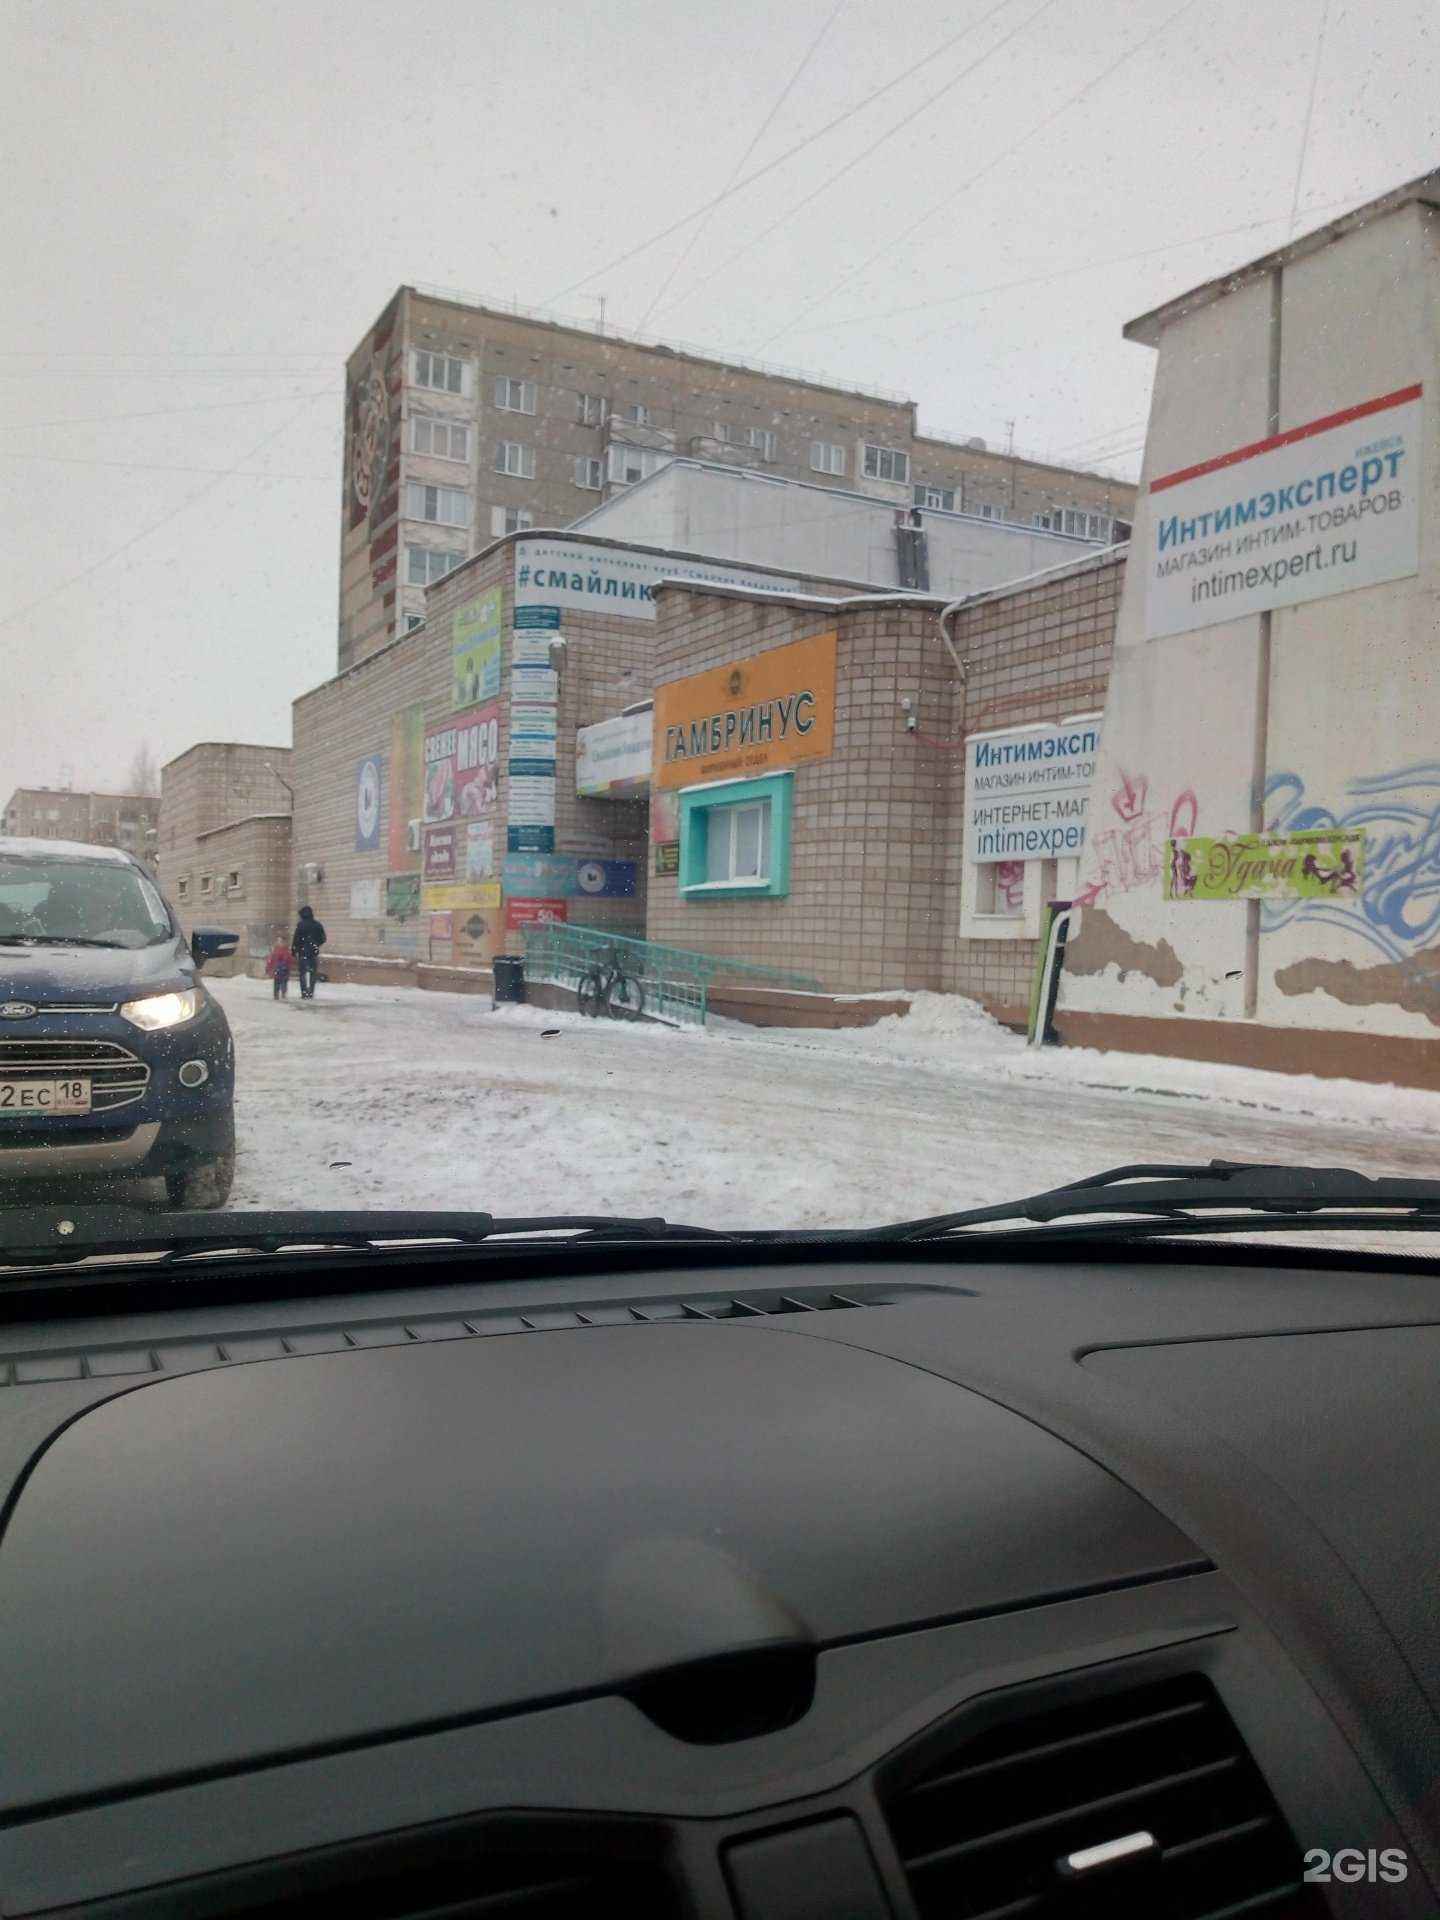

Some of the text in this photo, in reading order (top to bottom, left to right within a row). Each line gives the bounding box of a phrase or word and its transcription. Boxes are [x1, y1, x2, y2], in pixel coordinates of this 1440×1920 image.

[1157, 449, 1406, 551] Интимэксперт
[1156, 491, 1402, 579] МАГАЗИН ИНТИМ-ТОВАРОВ
[518, 564, 653, 602] #смайлик
[1191, 540, 1358, 603] intimexpert.ru
[457, 717, 498, 772] МЯСО
[664, 688, 817, 764] ГАМБРИНУС
[974, 773, 1025, 791] МАГАЗИН
